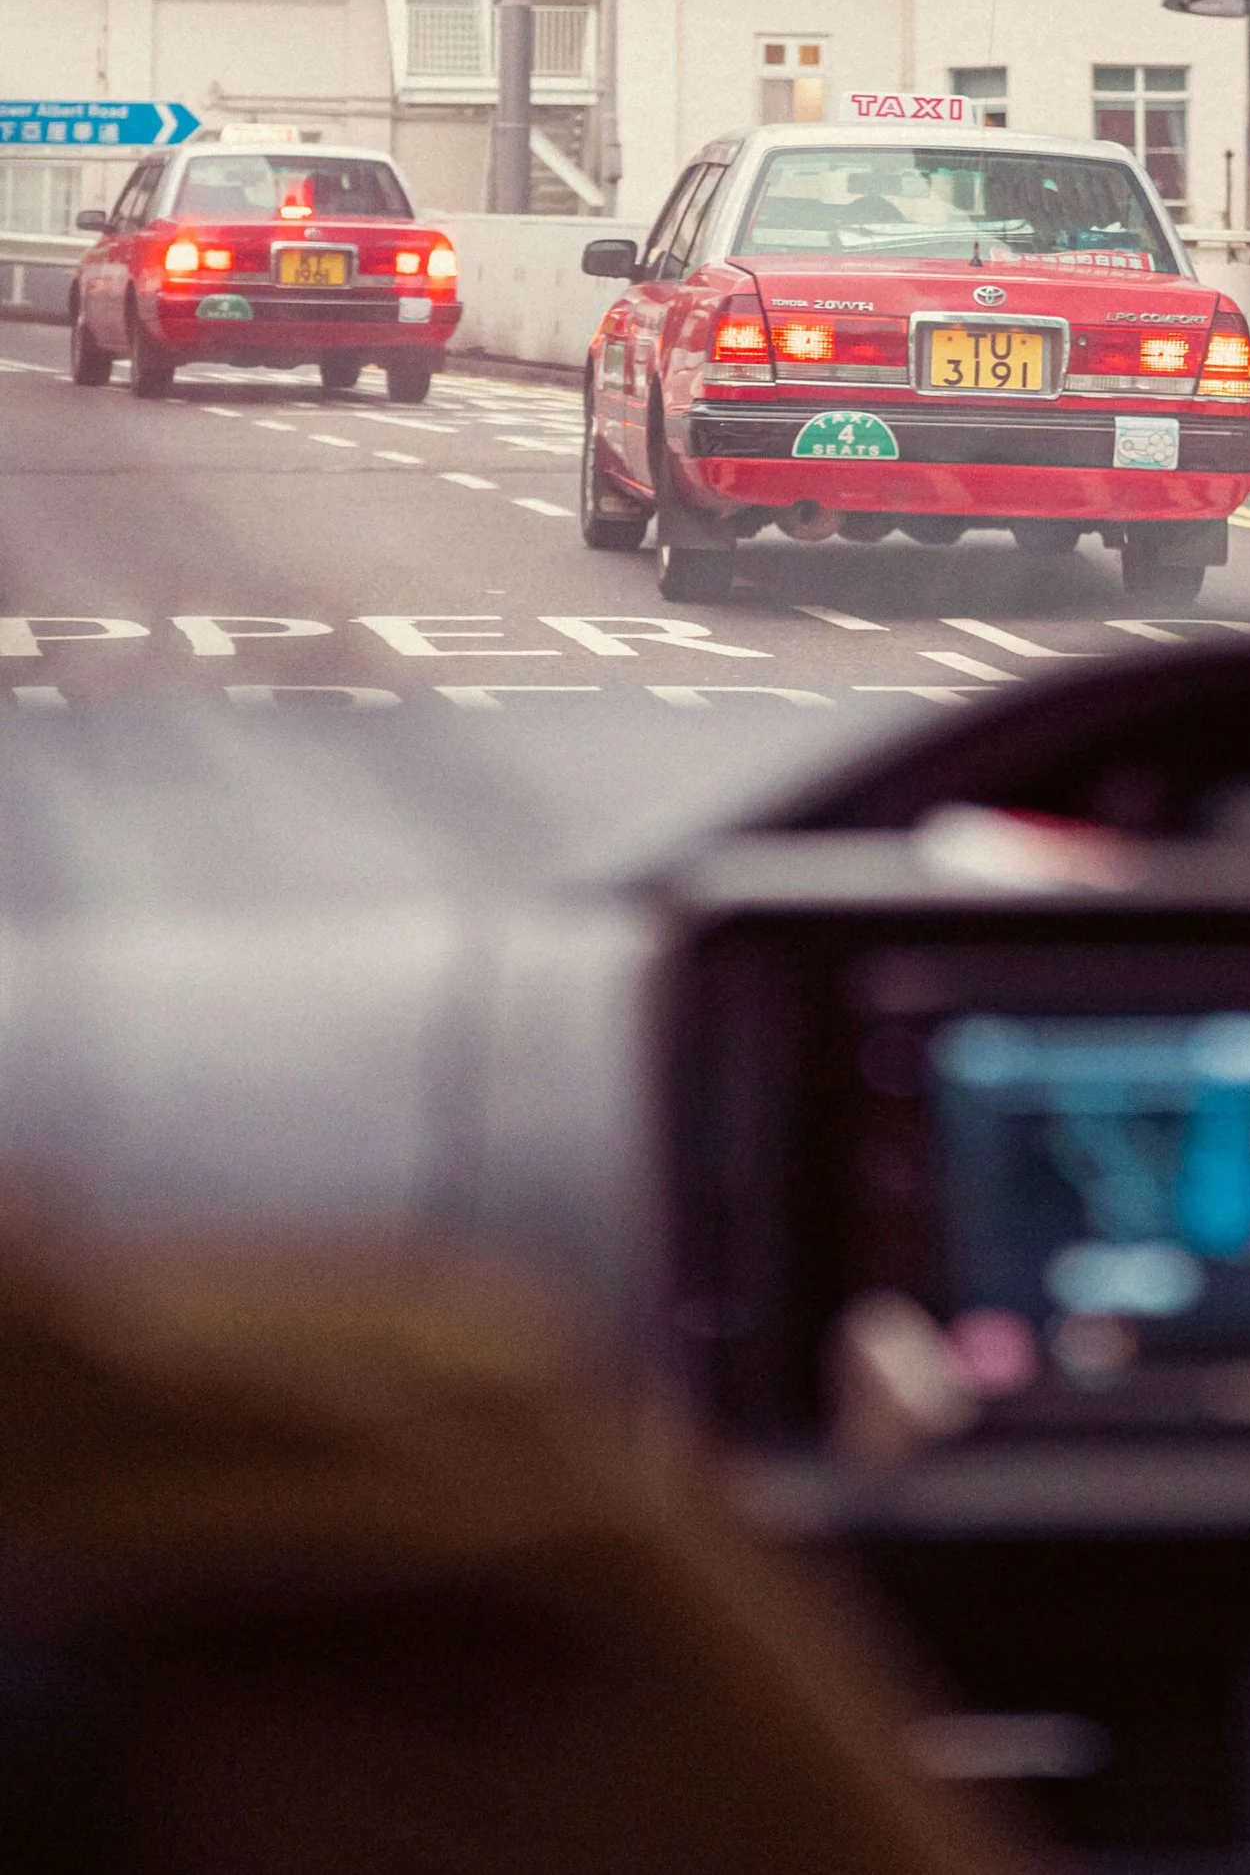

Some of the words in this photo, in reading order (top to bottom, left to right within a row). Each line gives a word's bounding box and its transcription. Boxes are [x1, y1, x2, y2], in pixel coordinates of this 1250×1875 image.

[88, 103, 130, 119] Road
[851, 94, 963, 121] TAXI
[771, 298, 809, 308] TOYOTA
[1106, 312, 1138, 323] LPG
[1140, 312, 1209, 325] COMFORT
[966, 332, 1013, 361] TU
[943, 359, 1029, 389] 3191
[813, 412, 875, 430] TAXI
[837, 424, 856, 445] 4
[812, 444, 881, 457] SEATS
